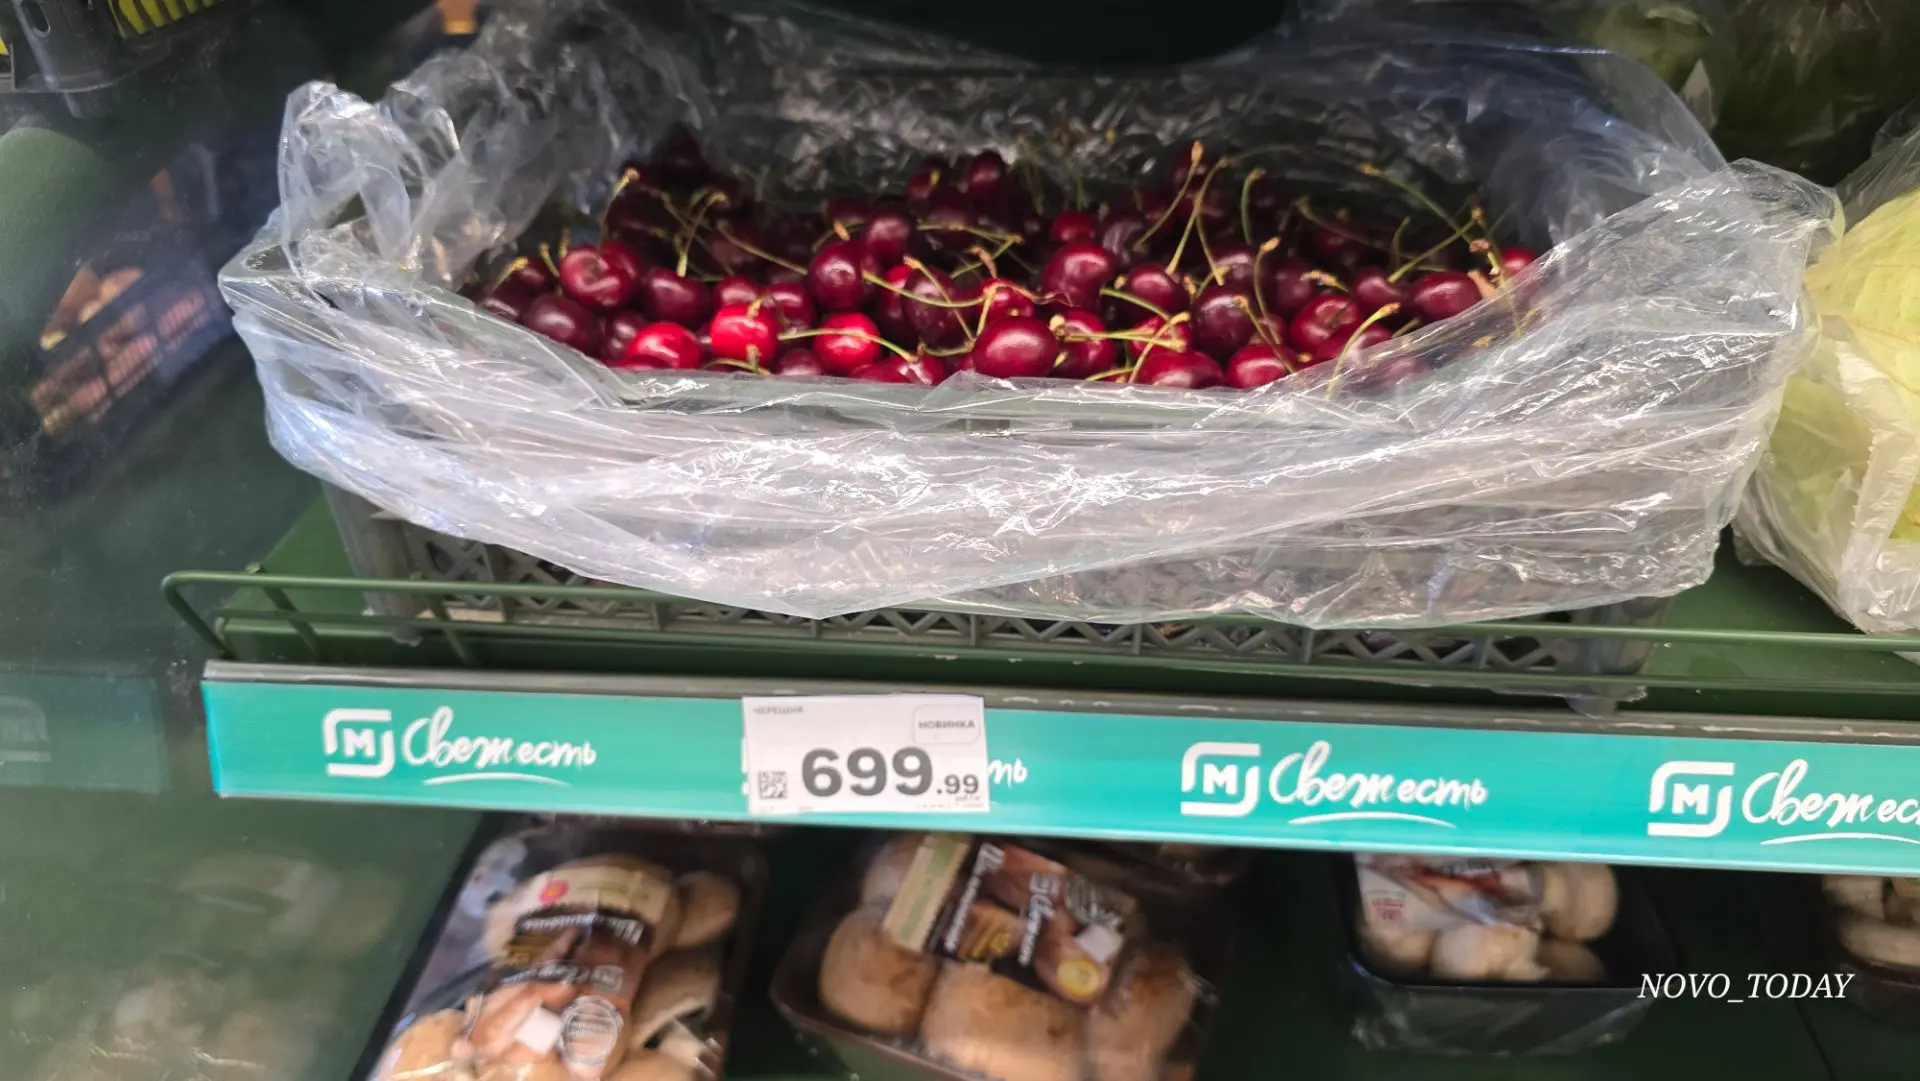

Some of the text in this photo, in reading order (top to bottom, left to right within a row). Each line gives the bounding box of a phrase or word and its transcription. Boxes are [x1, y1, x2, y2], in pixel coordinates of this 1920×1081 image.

[402, 706, 597, 769] Свежесть
[918, 719, 975, 730] НОВИНКА
[1268, 740, 1488, 811] Свежесть
[1741, 758, 1920, 828] Свежес
